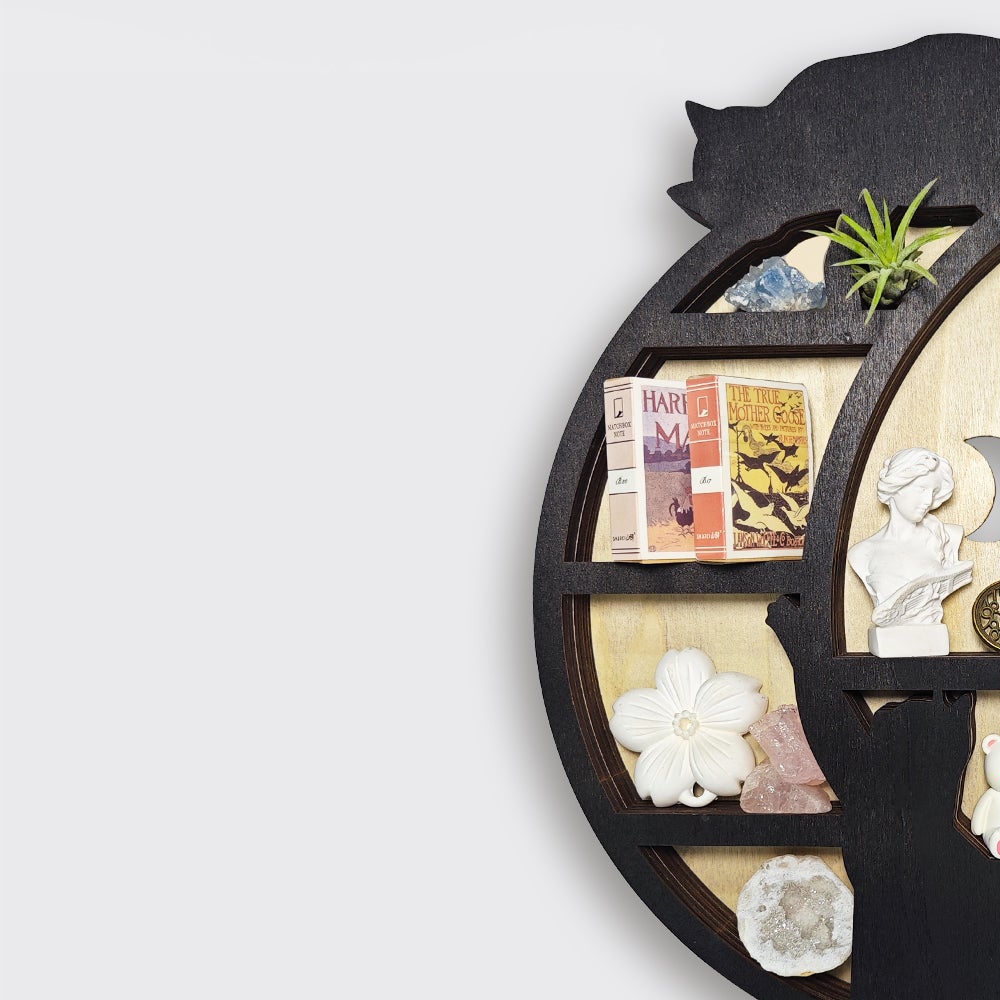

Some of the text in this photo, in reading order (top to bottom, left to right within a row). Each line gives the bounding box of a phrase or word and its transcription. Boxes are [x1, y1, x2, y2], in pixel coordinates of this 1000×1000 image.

[728, 385, 780, 404] THE TRUE
[728, 402, 806, 425] MOTHER GOOSE
